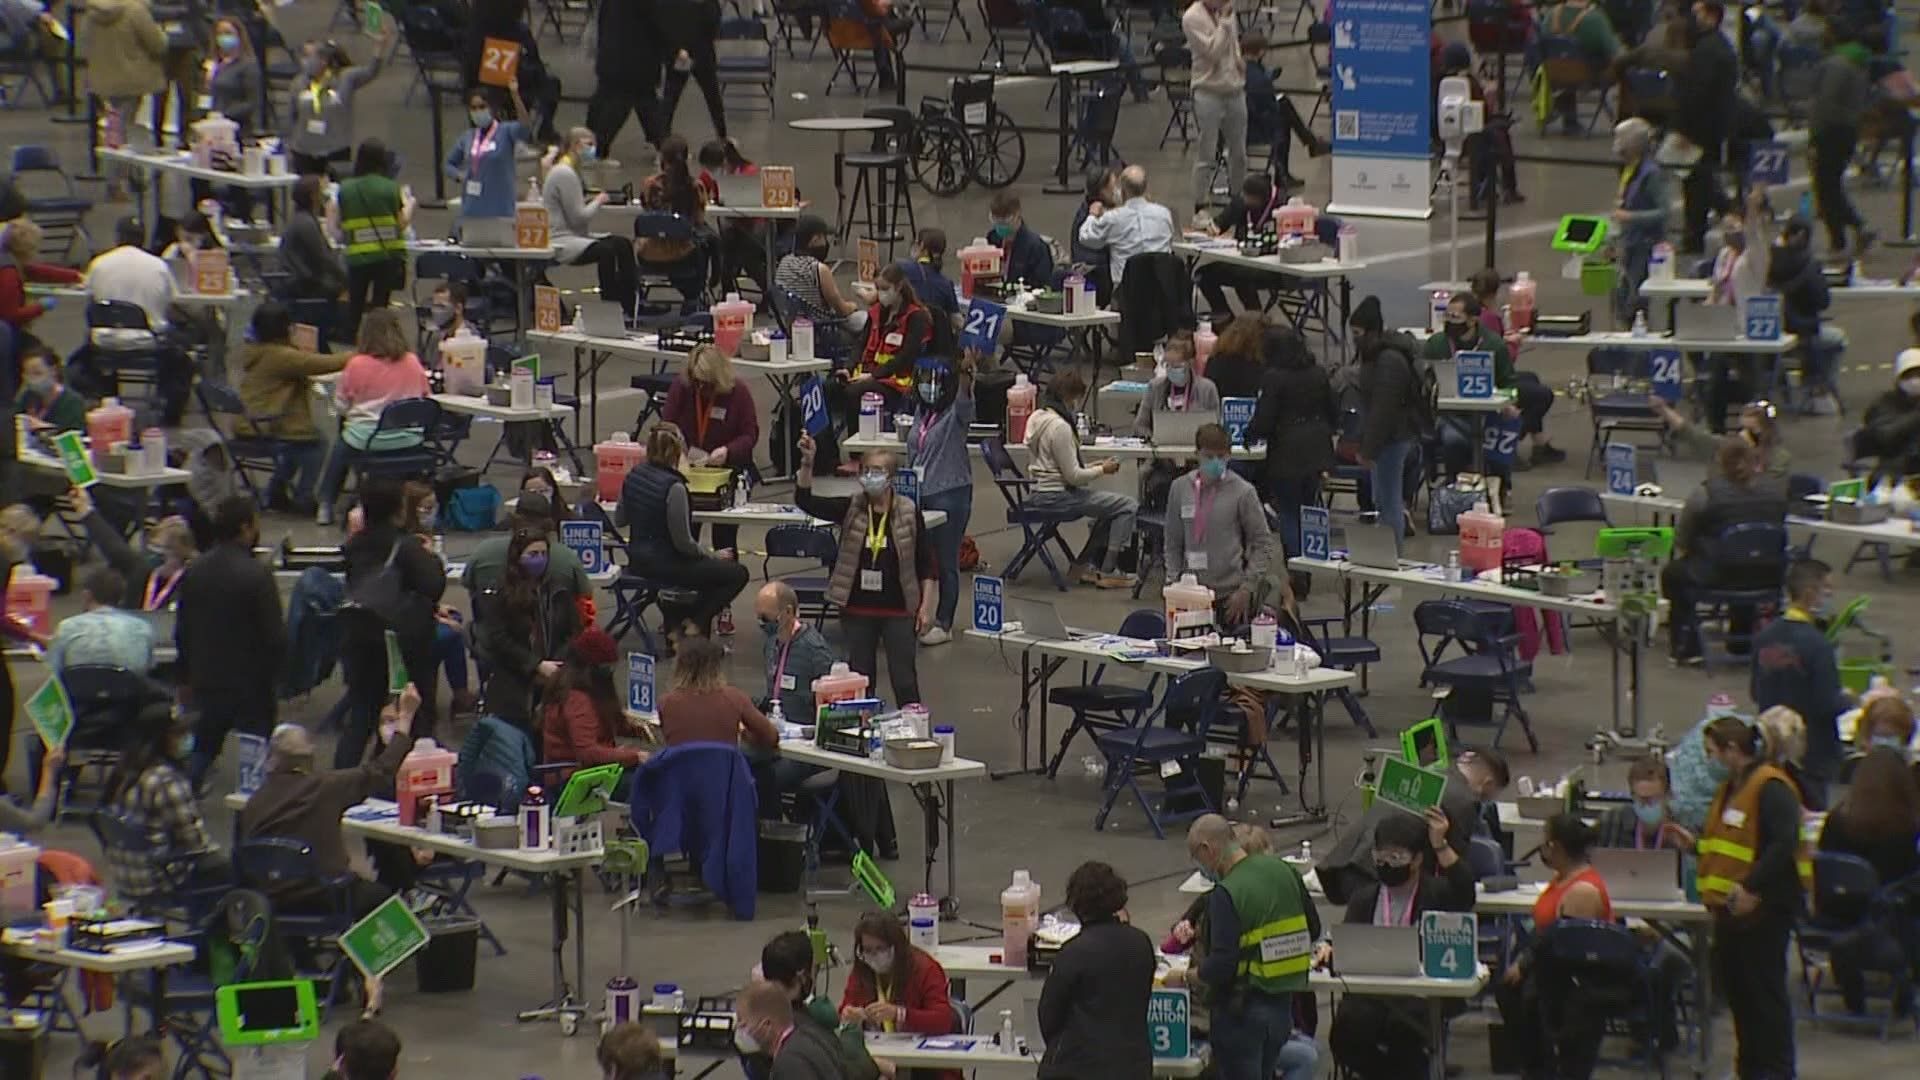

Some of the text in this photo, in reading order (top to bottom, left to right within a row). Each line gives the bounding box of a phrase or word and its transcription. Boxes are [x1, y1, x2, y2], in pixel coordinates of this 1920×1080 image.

[485, 48, 516, 71] 27
[1753, 150, 1786, 172] 27
[767, 189, 789, 205] 29
[520, 228, 545, 246] 27
[862, 261, 876, 280] 28
[965, 308, 999, 339] 21
[1750, 319, 1776, 338] 27
[1653, 356, 1680, 384] 24
[1463, 375, 1488, 394] 25
[802, 384, 821, 421] 20
[1611, 470, 1632, 489] 24
[563, 528, 590, 538] LINE
[1306, 534, 1326, 555] 22
[976, 582, 994, 594] LINE
[978, 604, 998, 625] 20
[632, 684, 650, 707] 18
[1426, 935, 1473, 946] STATION
[1440, 947, 1457, 973] 4
[1176, 999, 1186, 1013] A
[1154, 1025, 1170, 1052] 3
